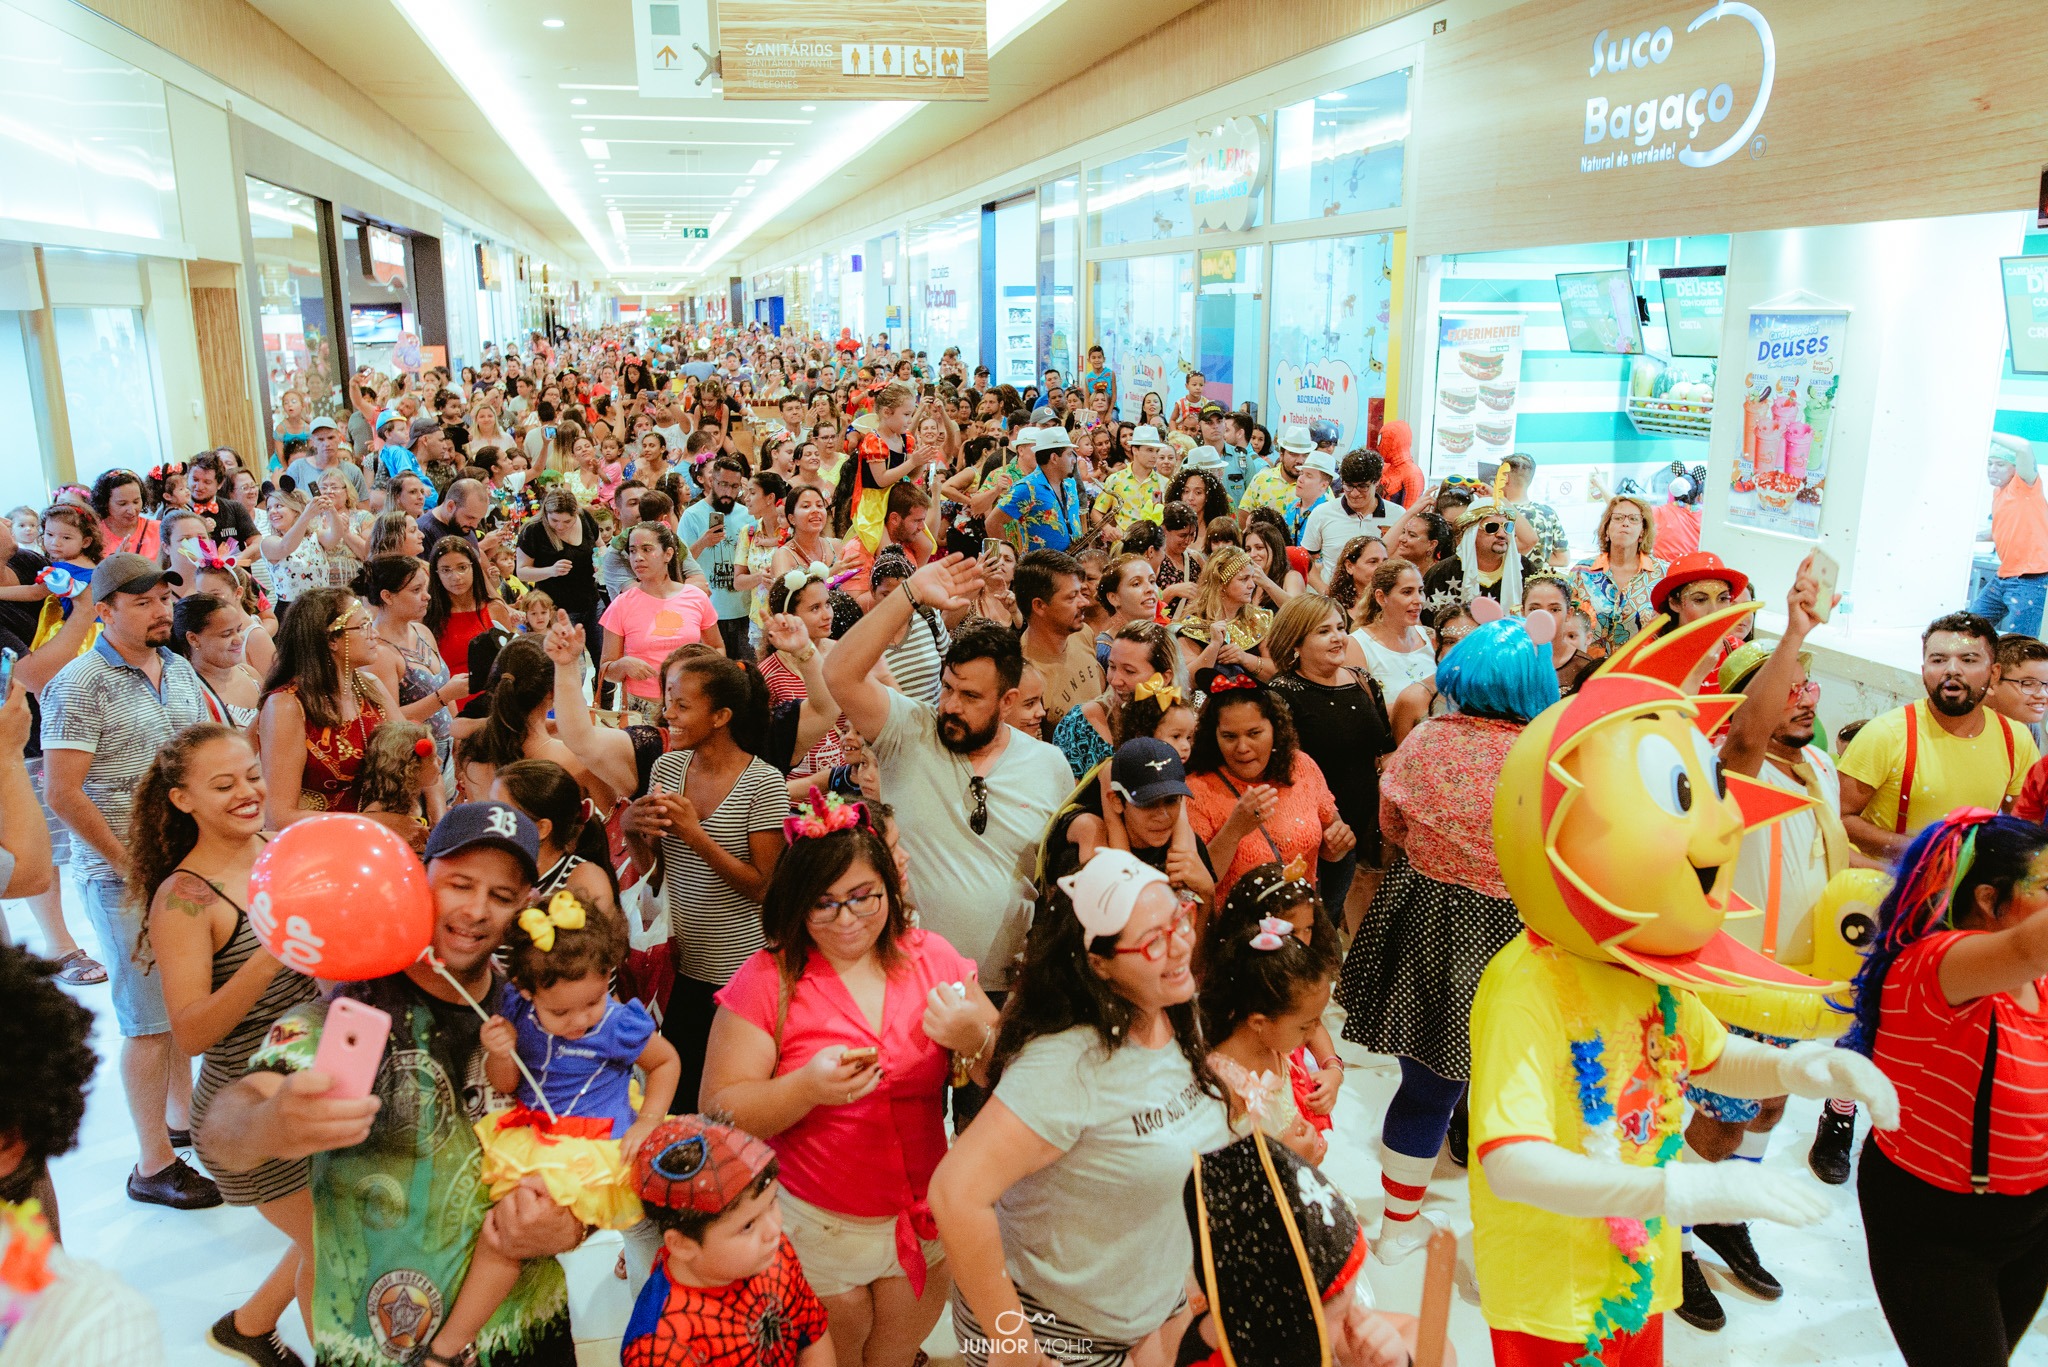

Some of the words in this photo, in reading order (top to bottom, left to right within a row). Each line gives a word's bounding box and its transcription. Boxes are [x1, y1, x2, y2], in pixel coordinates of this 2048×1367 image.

[745, 40, 833, 57] SANITÁRIOS
[1589, 25, 1674, 78] Suco
[746, 58, 793, 68] SANITÁRIO
[795, 59, 833, 68] INFANTIL
[746, 68, 796, 78] FRALDÁRIO
[748, 80, 799, 89] TELEFONES
[1583, 83, 1734, 146] Bagaço
[1580, 152, 1614, 173] Natural
[1616, 150, 1628, 167] de
[1631, 142, 1677, 164] verdade!
[1676, 281, 1723, 297] DEUSES
[1448, 325, 1520, 341] EXPERIMENTE!
[1803, 324, 1819, 336] dos
[1757, 336, 1829, 361] Deuses
[1294, 374, 1309, 392] TIA
[1311, 374, 1335, 395] LENE
[1297, 394, 1331, 406] RECREAÇÕES
[1289, 412, 1307, 424] Tabela
